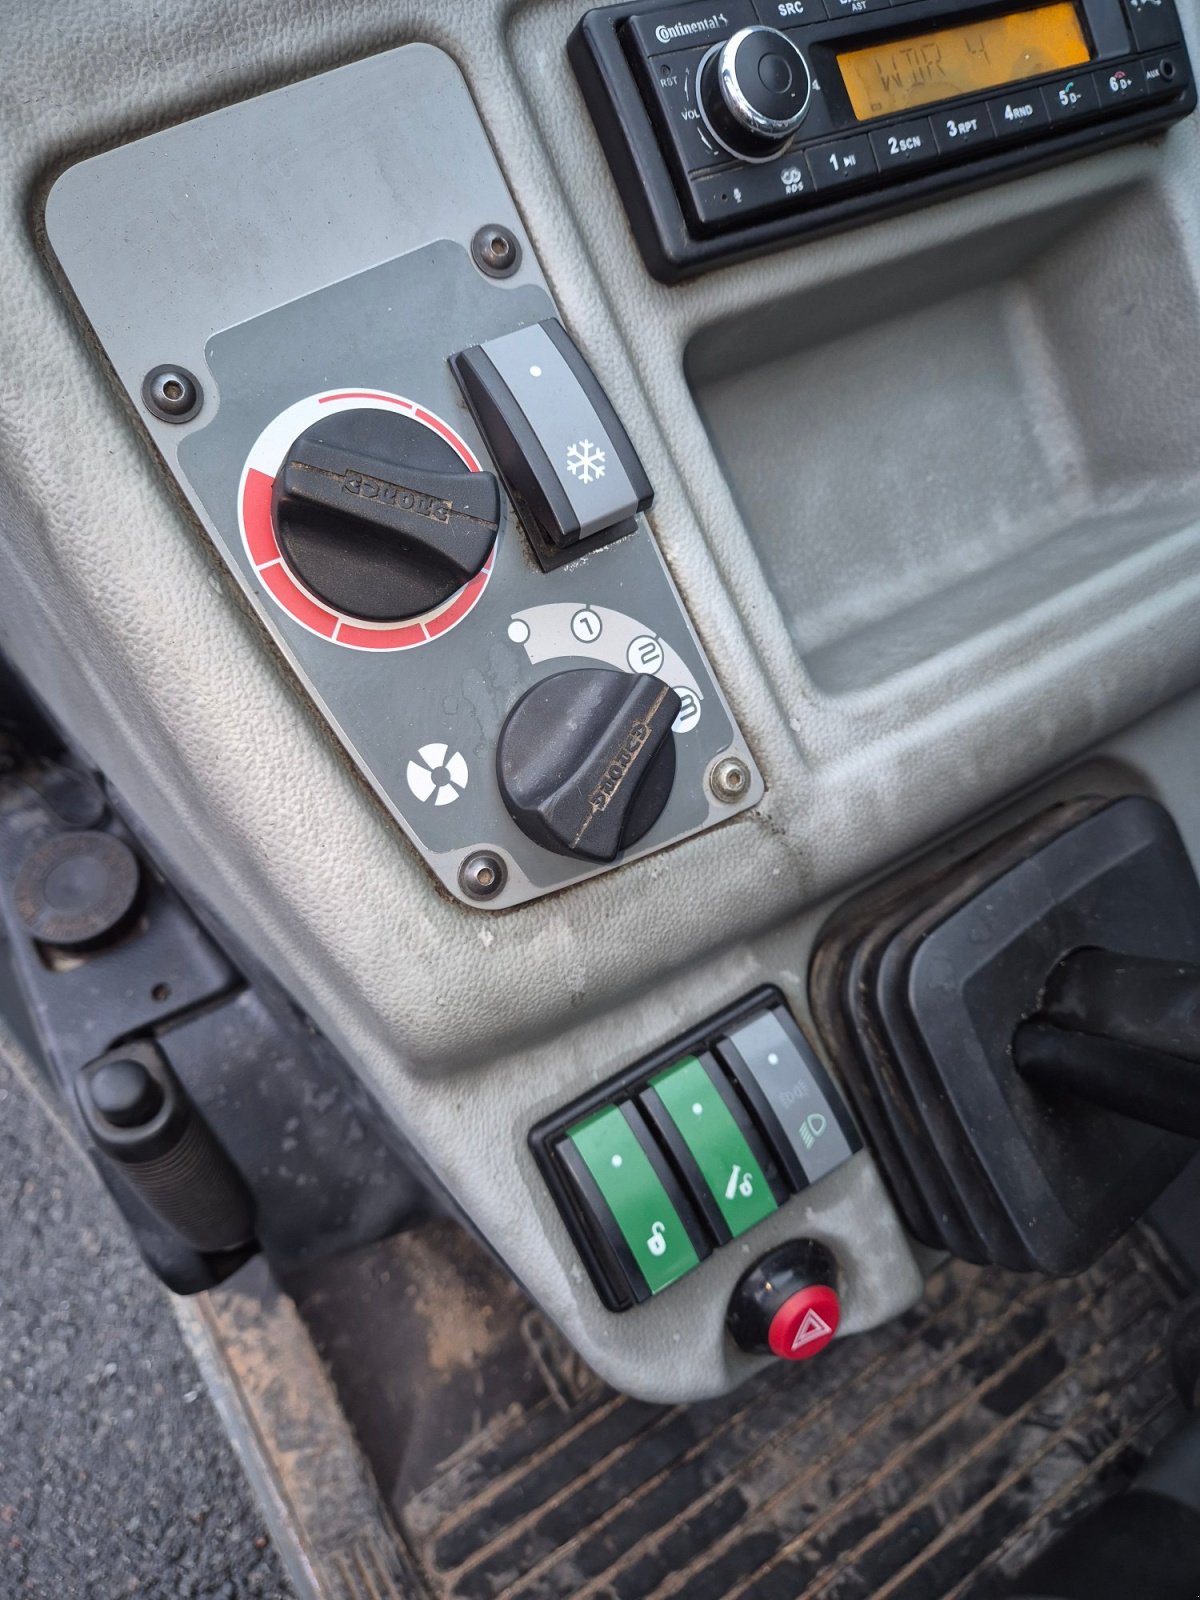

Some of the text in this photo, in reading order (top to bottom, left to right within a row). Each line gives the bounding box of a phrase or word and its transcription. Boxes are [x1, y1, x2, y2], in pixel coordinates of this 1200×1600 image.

[778, 1, 804, 16] SRC
[851, 1, 867, 12] AST
[655, 15, 720, 43] Continental
[1146, 68, 1160, 79] AUX
[660, 75, 678, 88] RST
[681, 108, 701, 120] VOL
[785, 181, 804, 195] RDS
[579, 617, 594, 636] 1
[638, 642, 661, 665] 2
